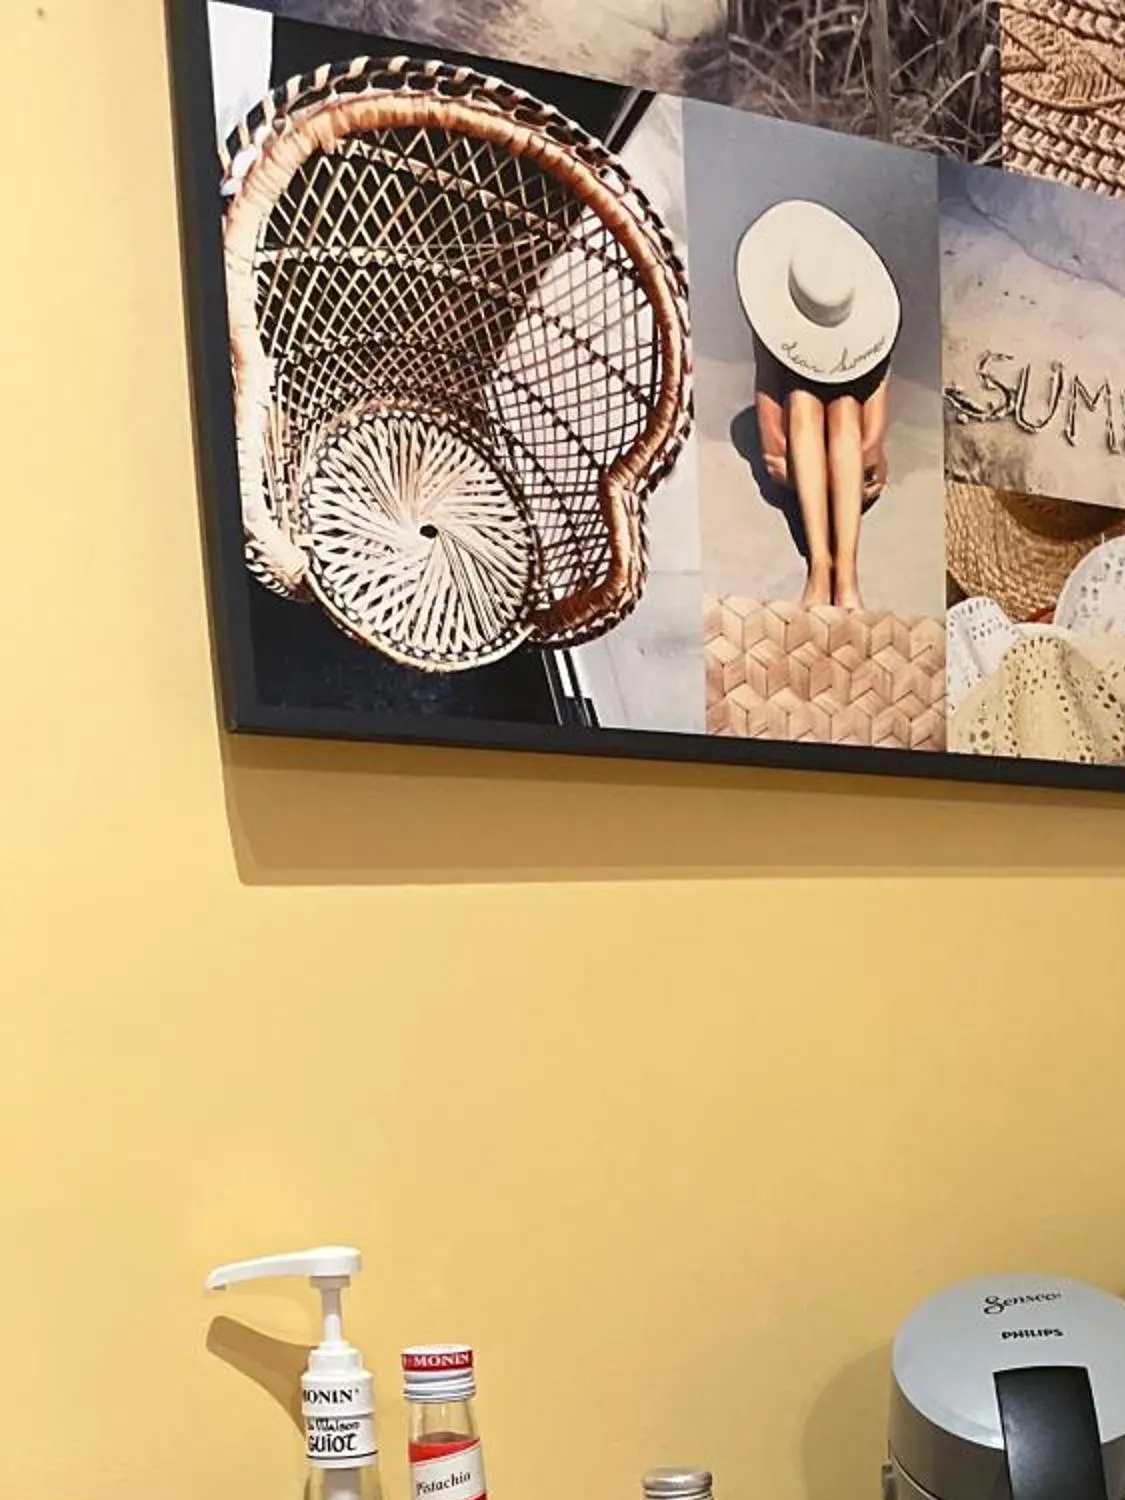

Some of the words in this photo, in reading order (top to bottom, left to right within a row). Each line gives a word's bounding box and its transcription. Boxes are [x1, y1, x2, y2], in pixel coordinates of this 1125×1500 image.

[983, 1292, 1062, 1315] Senseo
[1001, 1328, 1064, 1340] PHILIPS
[414, 1353, 469, 1367] MONIN
[415, 1470, 472, 1497] Pistachio
